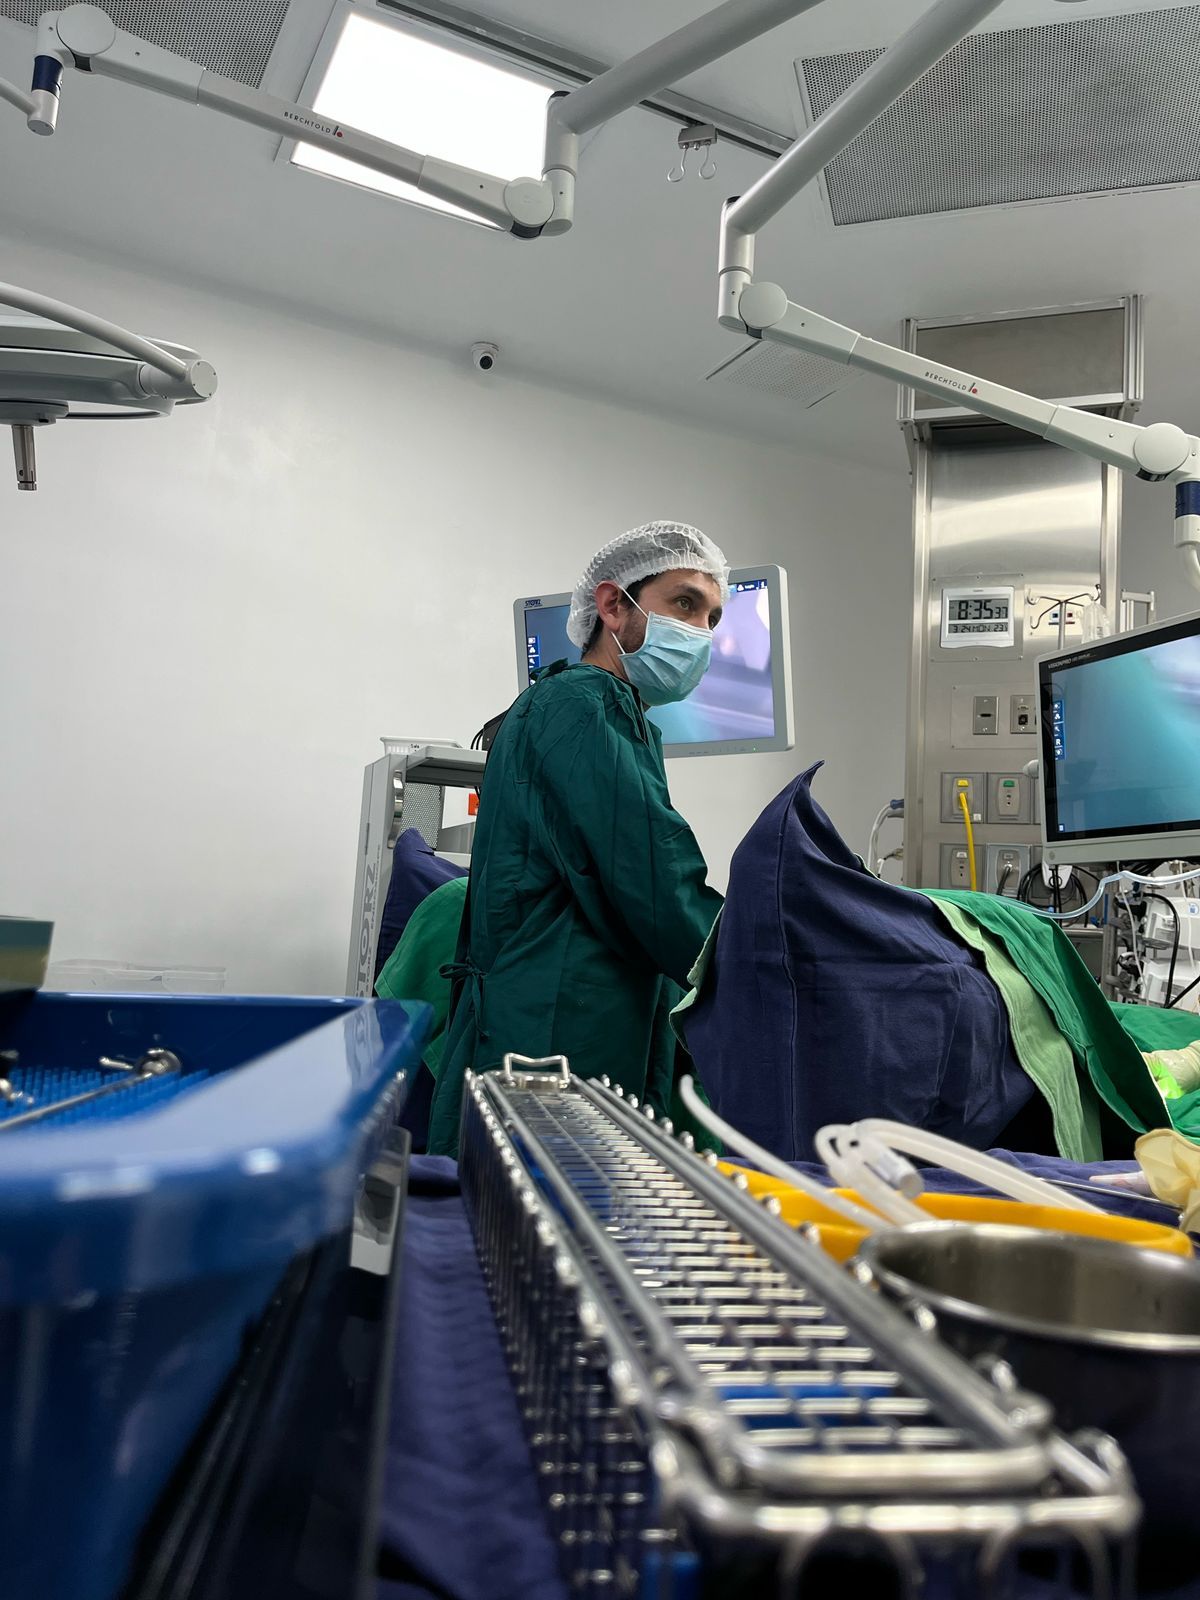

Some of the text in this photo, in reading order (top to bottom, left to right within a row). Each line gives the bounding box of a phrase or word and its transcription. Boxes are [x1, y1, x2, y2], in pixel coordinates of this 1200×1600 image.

[284, 111, 331, 133] BERCHTOLD
[925, 371, 967, 390] BERCHTOLD
[957, 599, 1008, 620] 8:35 37
